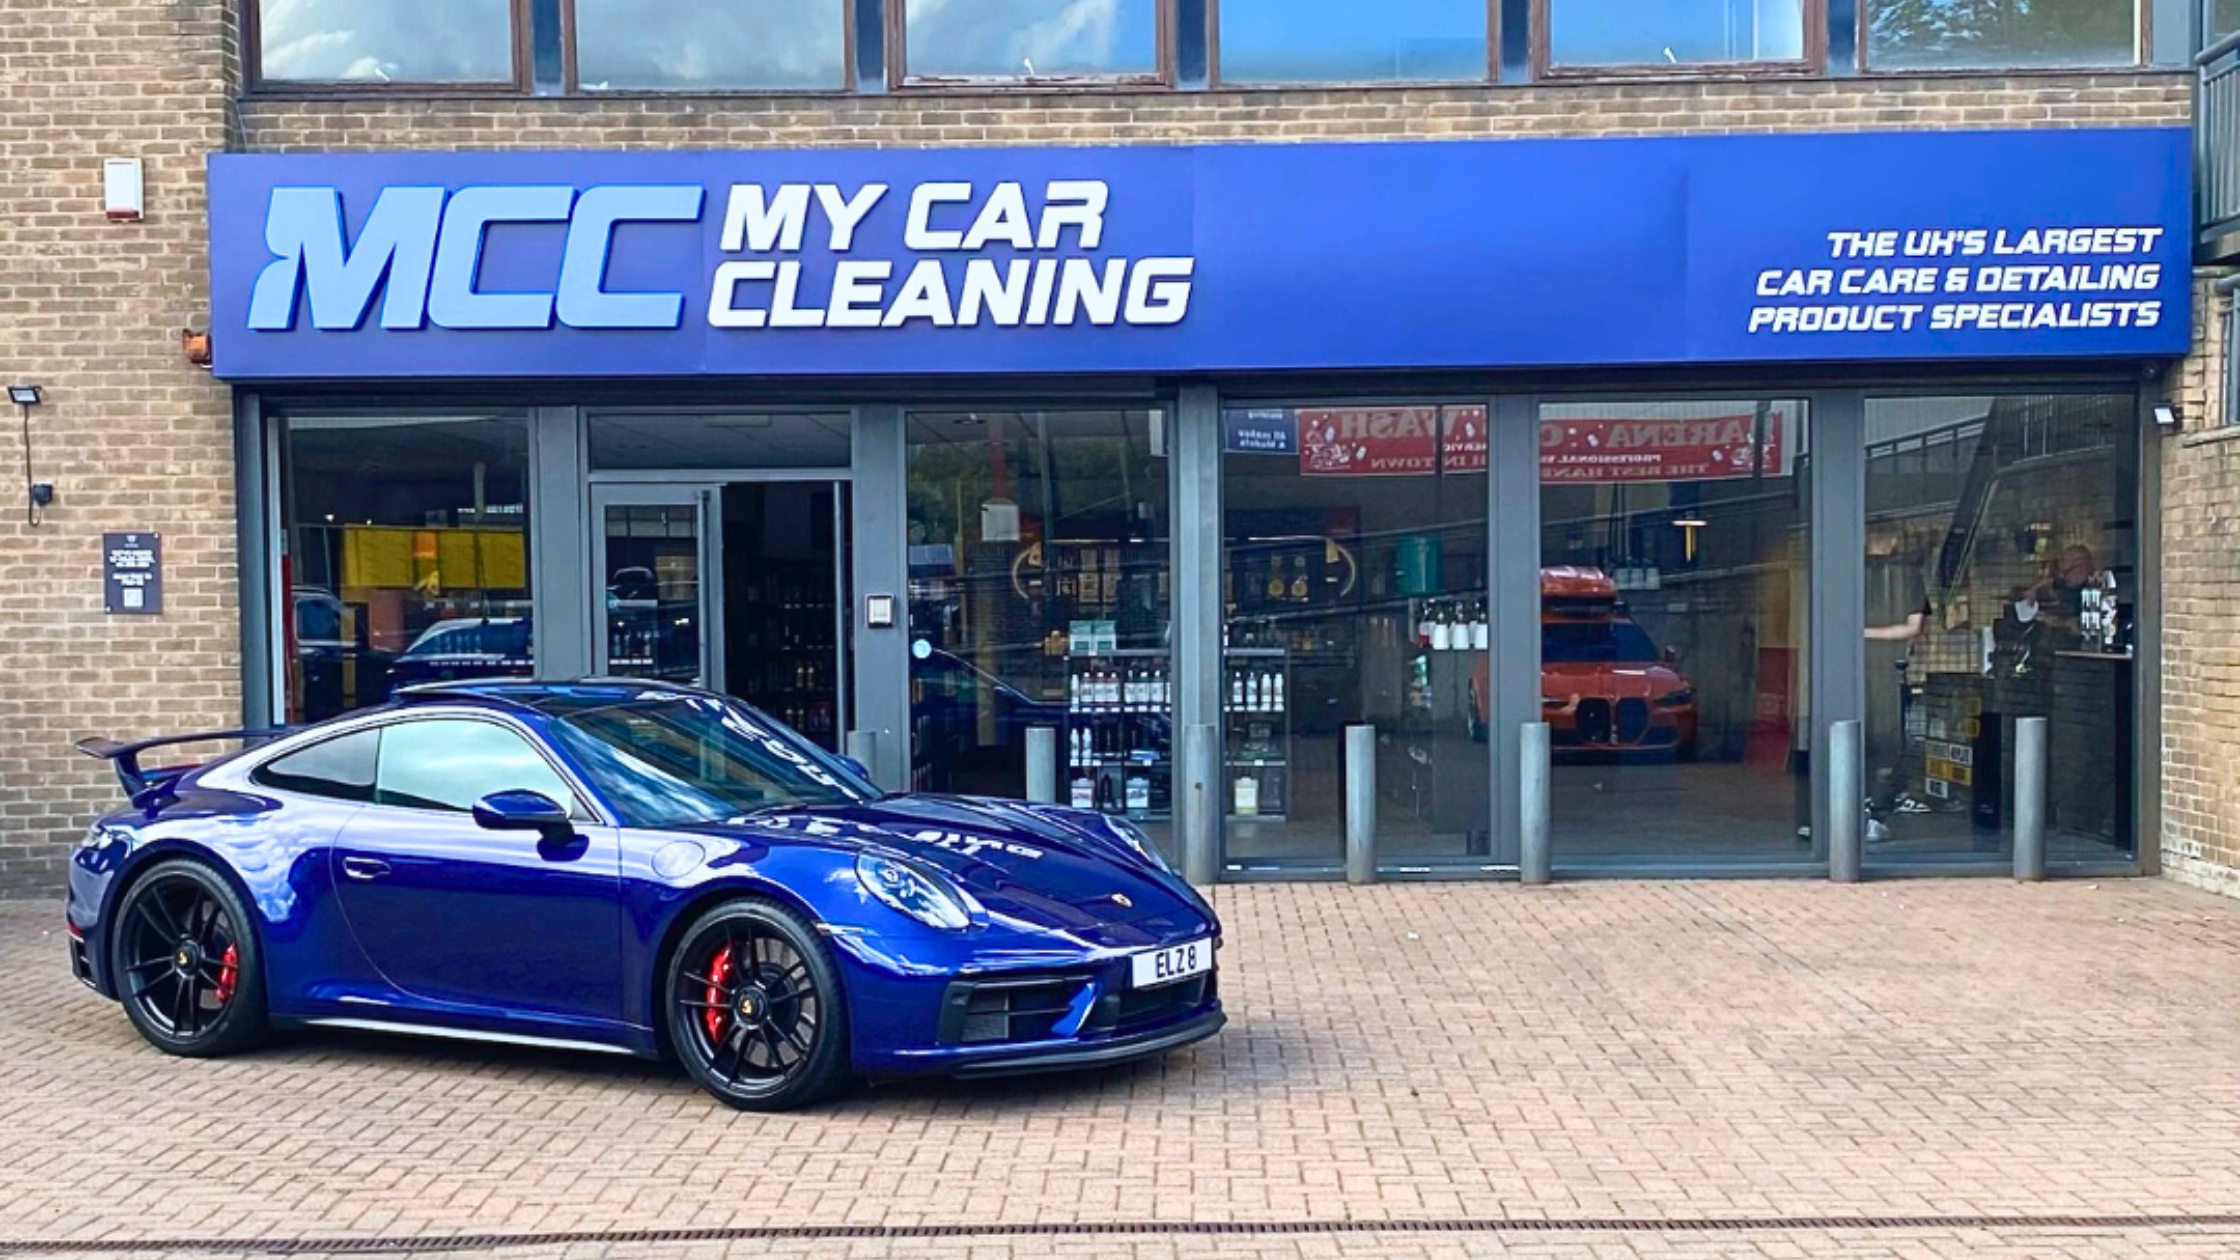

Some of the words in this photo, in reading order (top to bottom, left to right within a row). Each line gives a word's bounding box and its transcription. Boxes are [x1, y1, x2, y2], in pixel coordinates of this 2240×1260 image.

[720, 183, 890, 252] MY
[903, 180, 1109, 251] CAR
[247, 185, 707, 330] MCC
[1827, 231, 1899, 258] THE
[1993, 227, 2163, 255] LARGEST
[707, 256, 1195, 328] CLEANING
[1756, 270, 1831, 296] CAR
[1839, 267, 1938, 295] CARE
[1945, 266, 1971, 293] &
[1976, 263, 2161, 292] DETAILING
[1748, 304, 1924, 333] PRODUCT
[1929, 301, 2161, 330] SPECIALISTS
